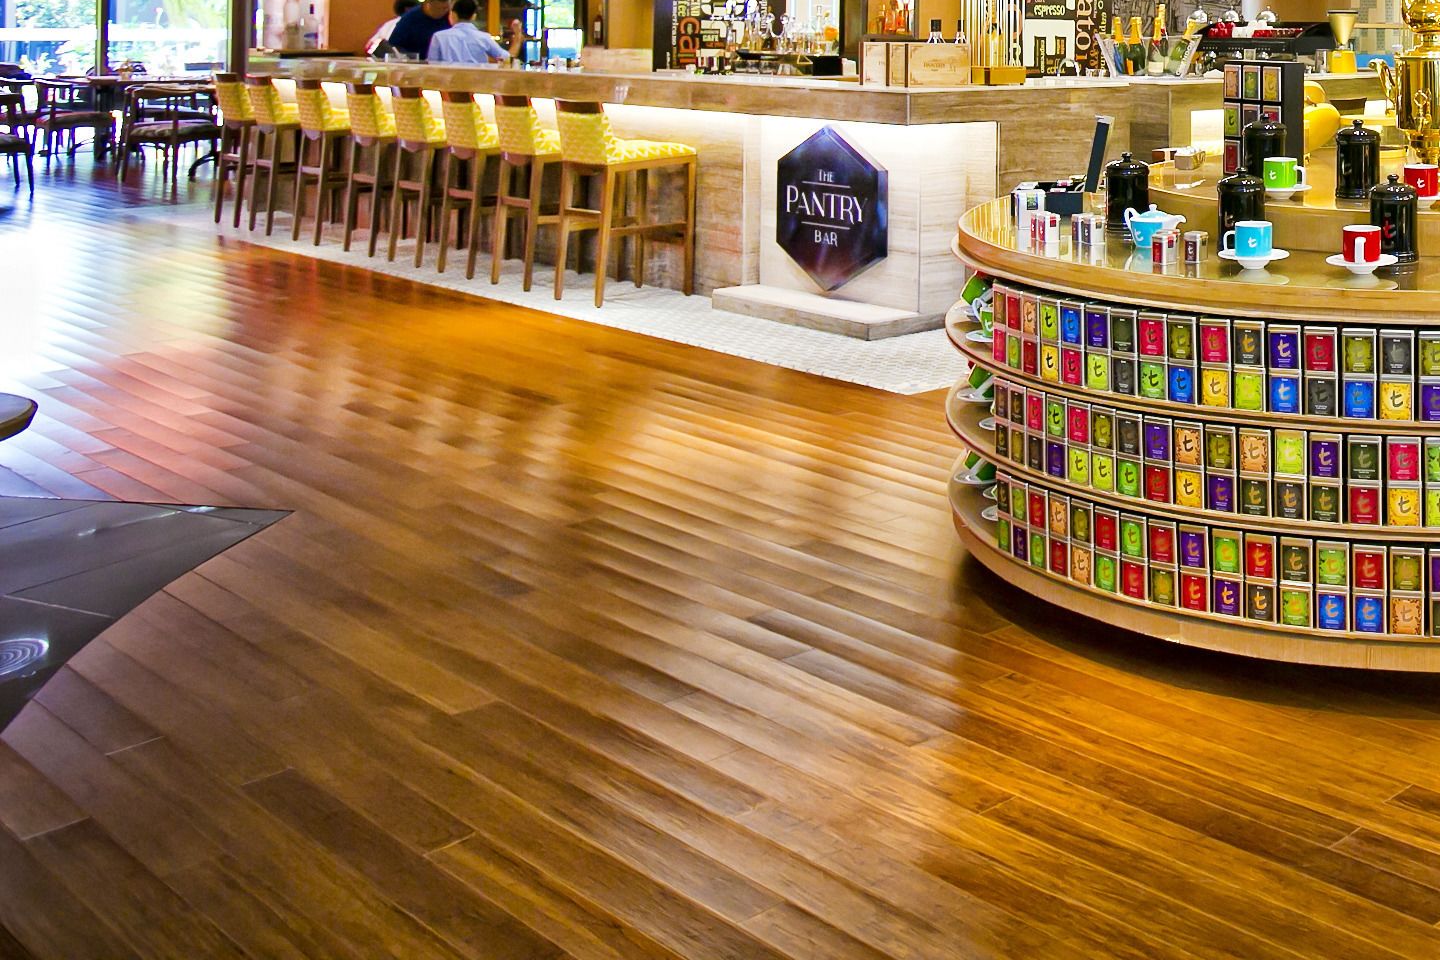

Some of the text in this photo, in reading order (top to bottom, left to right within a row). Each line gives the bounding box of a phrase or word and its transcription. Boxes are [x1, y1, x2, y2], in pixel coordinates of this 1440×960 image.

[1034, 4, 1066, 18] espresso
[817, 169, 834, 183] THE
[786, 185, 868, 224] PANTRY
[814, 230, 838, 247] BAR
